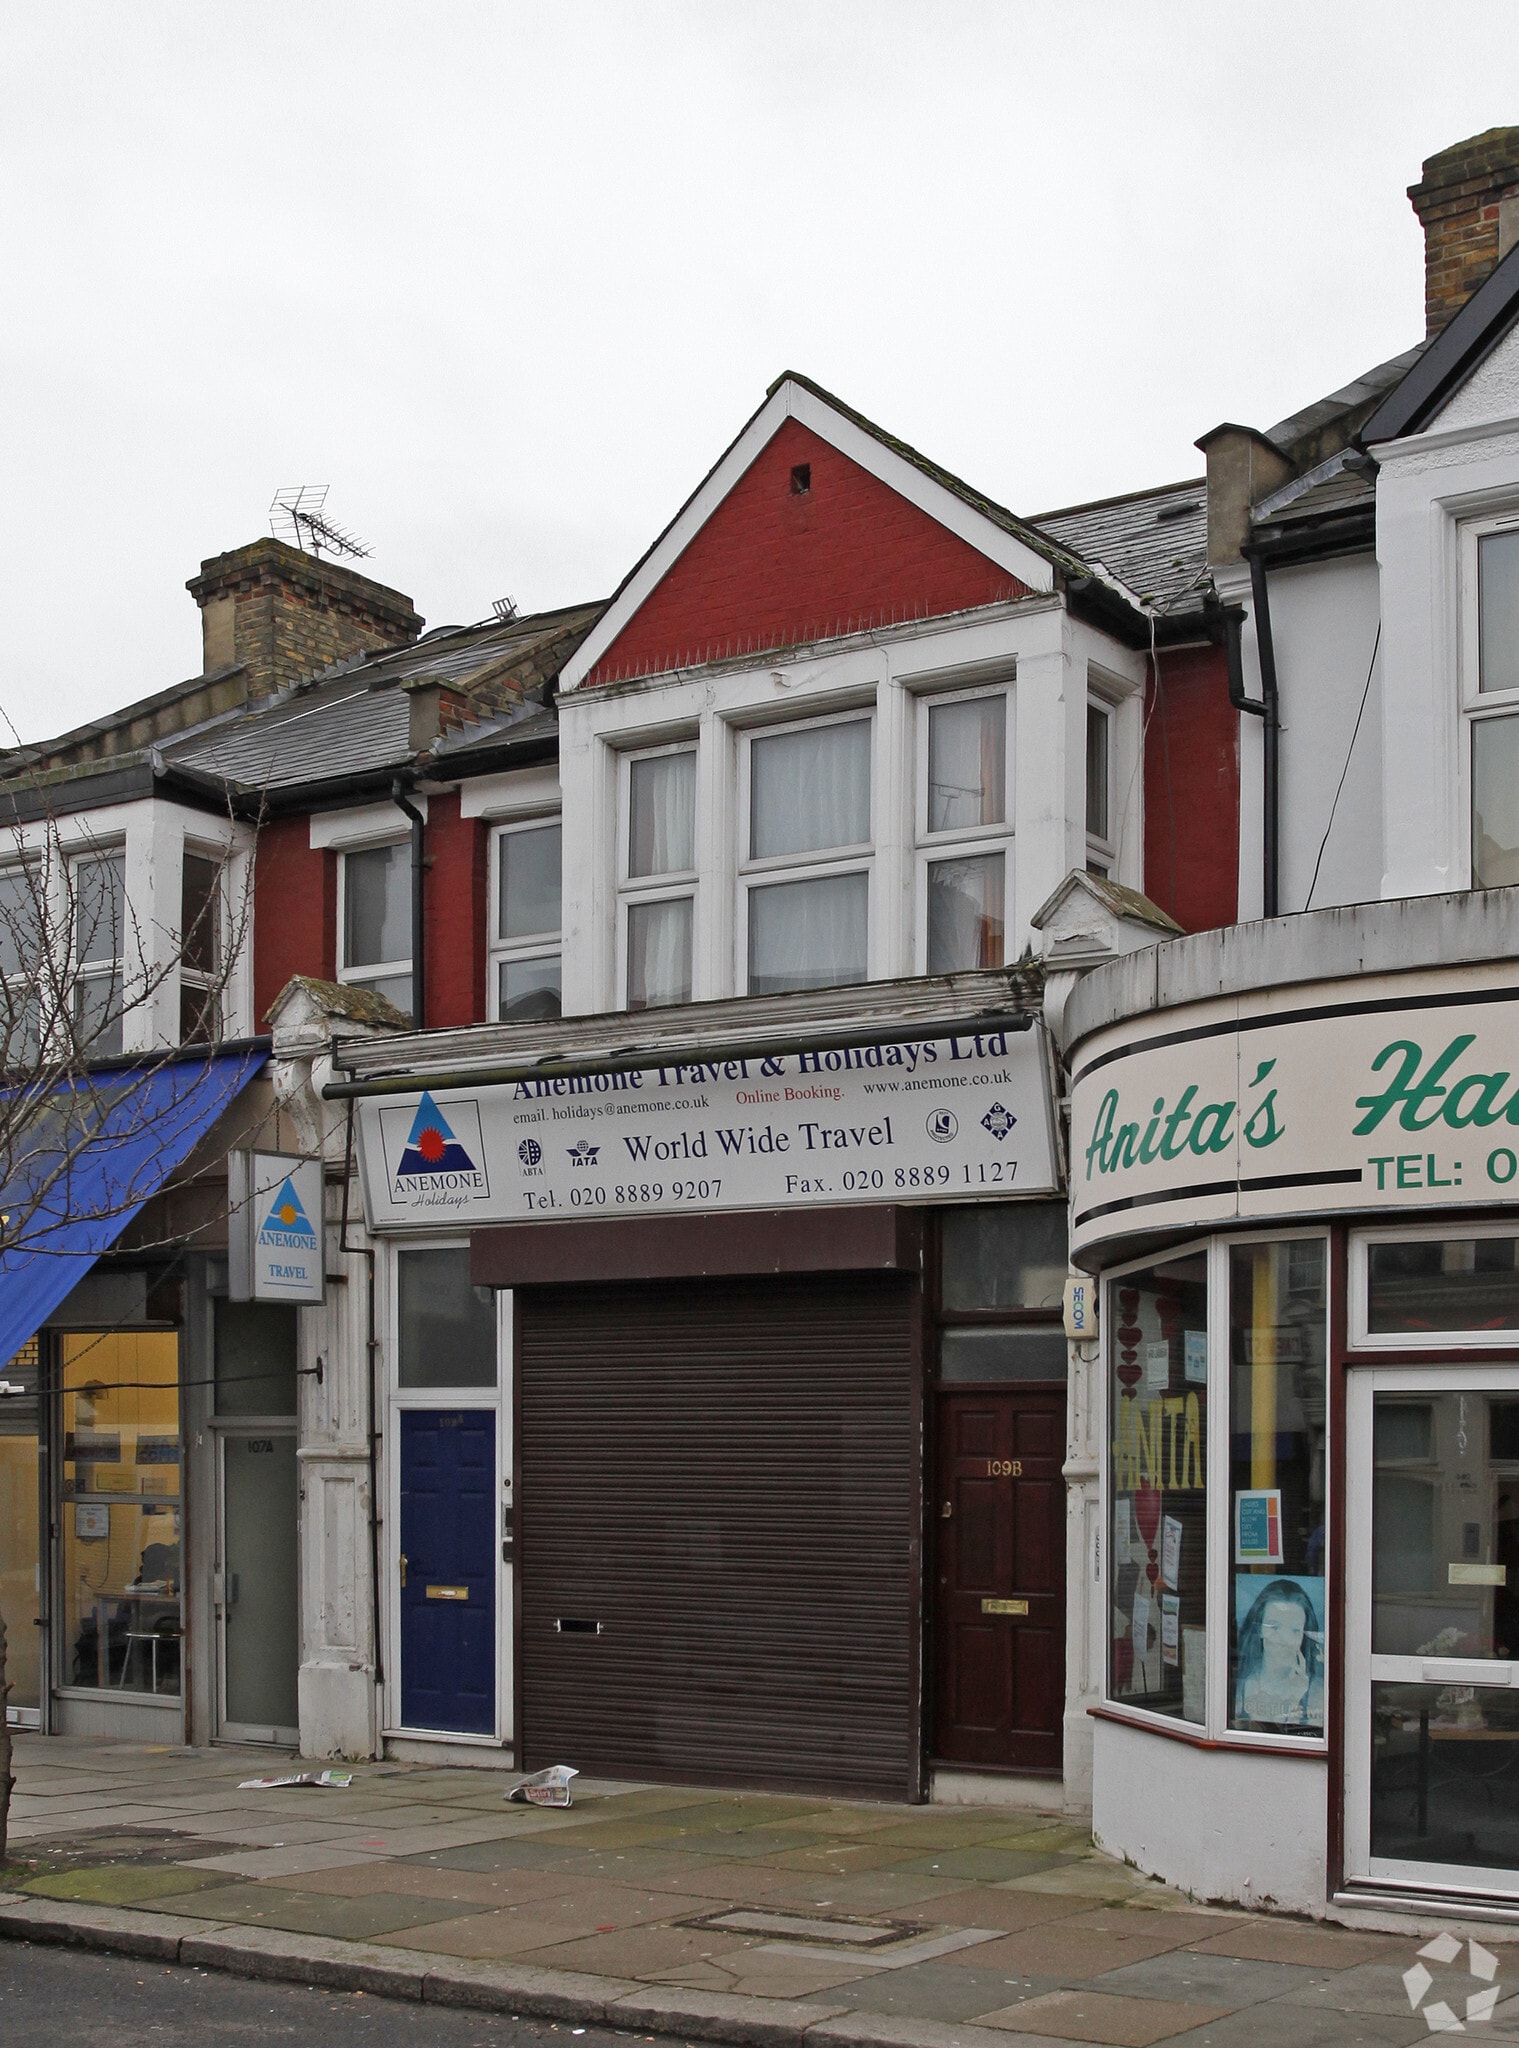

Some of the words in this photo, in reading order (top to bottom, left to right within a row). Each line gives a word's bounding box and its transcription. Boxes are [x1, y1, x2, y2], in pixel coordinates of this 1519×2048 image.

[513, 1069, 644, 1100] Anemone
[657, 1058, 750, 1087] Travel
[760, 1057, 786, 1077] &
[798, 1040, 938, 1072] Holidays
[950, 1032, 1009, 1061] Ltd
[863, 1069, 1013, 1095] www.anemone.co.uk
[736, 1089, 780, 1105] Online
[784, 1084, 845, 1102] Booking.
[513, 1108, 549, 1124] email.
[552, 1094, 710, 1120] holidays@anemone.co.uk
[1086, 1058, 1286, 1182] Anita's
[622, 1131, 707, 1162] World
[715, 1124, 791, 1157] Wide
[798, 1117, 895, 1151] Travel
[522, 1167, 544, 1177] ABTA
[571, 1154, 598, 1167] IATA
[1367, 1153, 1462, 1190] TEL:
[393, 1172, 484, 1193] ANEMONE
[785, 1174, 832, 1194] Fax.
[842, 1169, 884, 1191] 020
[894, 1165, 950, 1188] 8889
[962, 1161, 1019, 1184] 1127
[410, 1193, 470, 1208] Holidays
[523, 1191, 562, 1210] Tel.
[570, 1187, 606, 1207] 020
[614, 1183, 663, 1204] 8889
[672, 1180, 722, 1201] 9207
[258, 1231, 317, 1250] ANEMONE
[268, 1264, 308, 1279] TRAVEL
[1073, 1286, 1085, 1329] SECOM
[247, 1440, 275, 1454] 107A
[986, 1460, 1023, 1477] 109B
